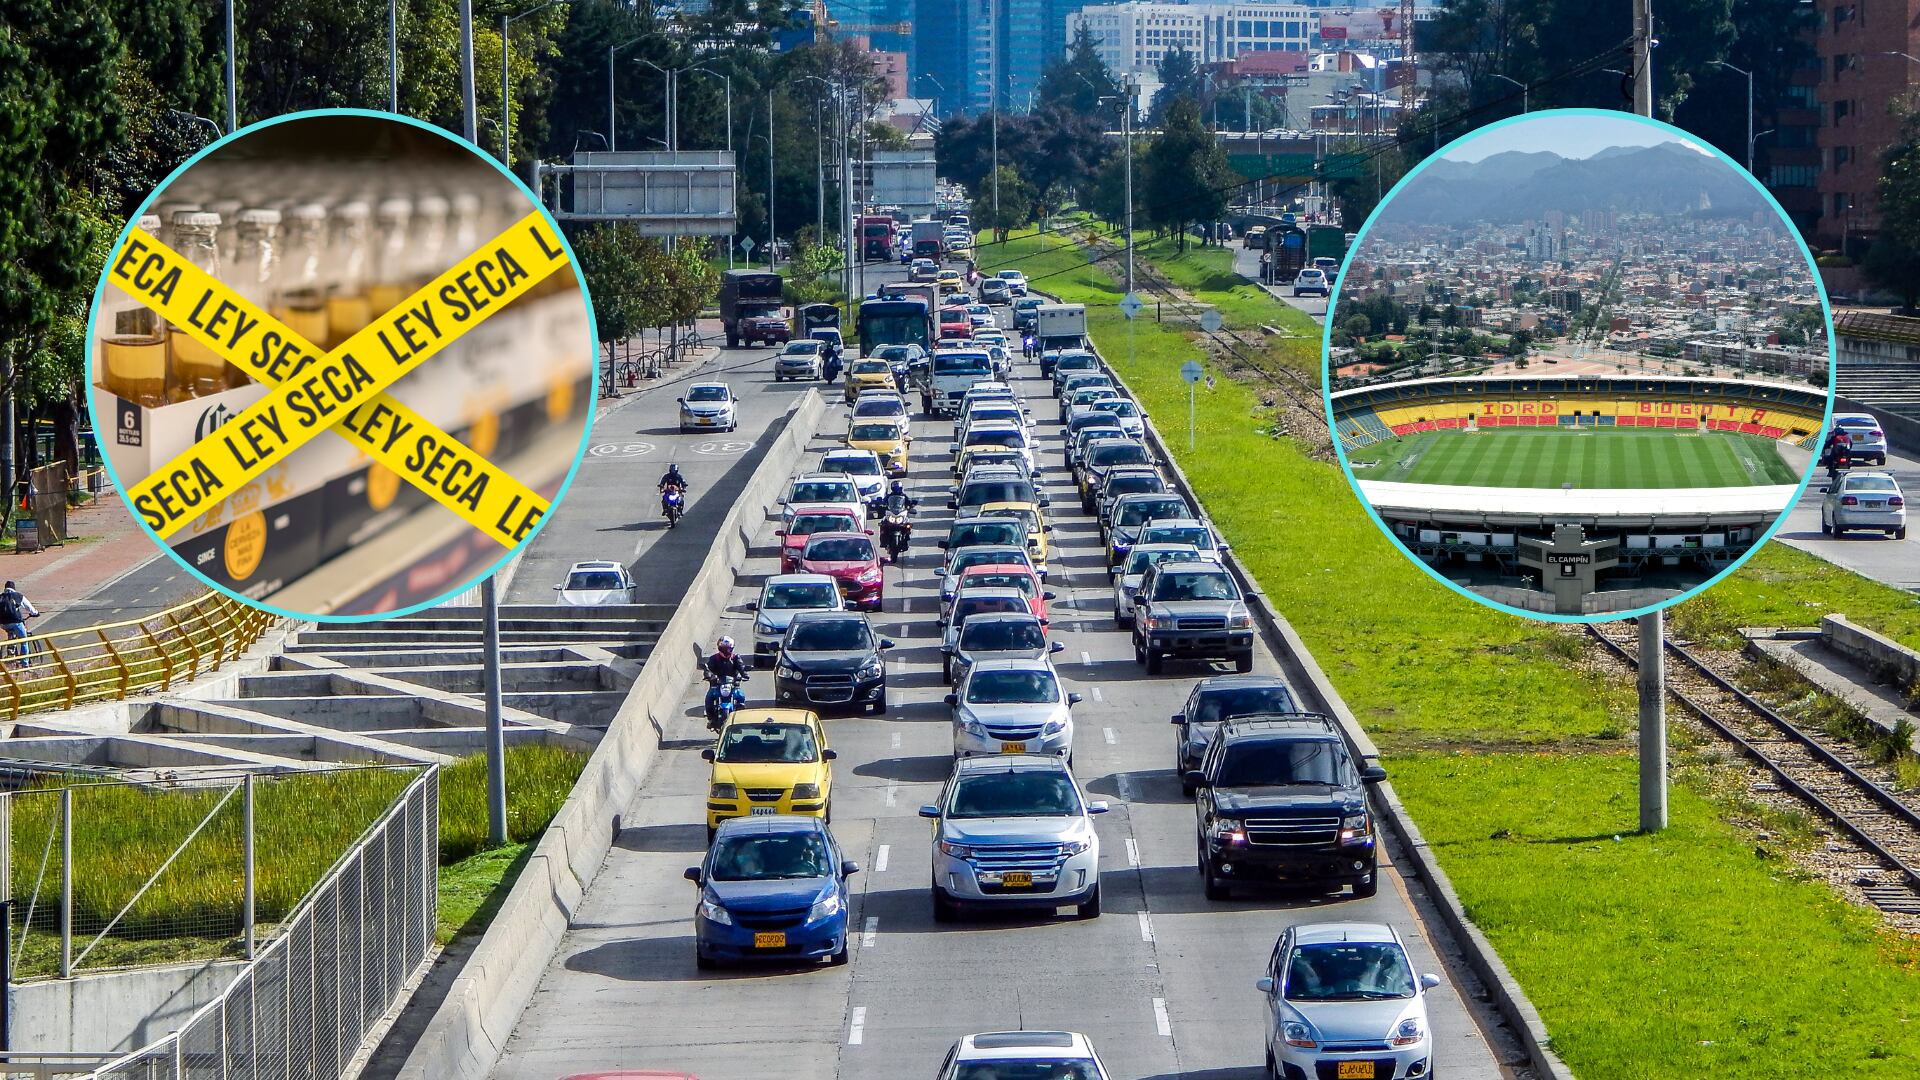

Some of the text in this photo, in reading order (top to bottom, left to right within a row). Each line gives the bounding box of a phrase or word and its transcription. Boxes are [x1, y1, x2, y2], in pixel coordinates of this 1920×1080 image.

[1483, 403, 1554, 415] IDRD
[124, 410, 135, 429] 6
[197, 548, 215, 565] SINCE
[1558, 555, 1589, 564] CAMPÍN
